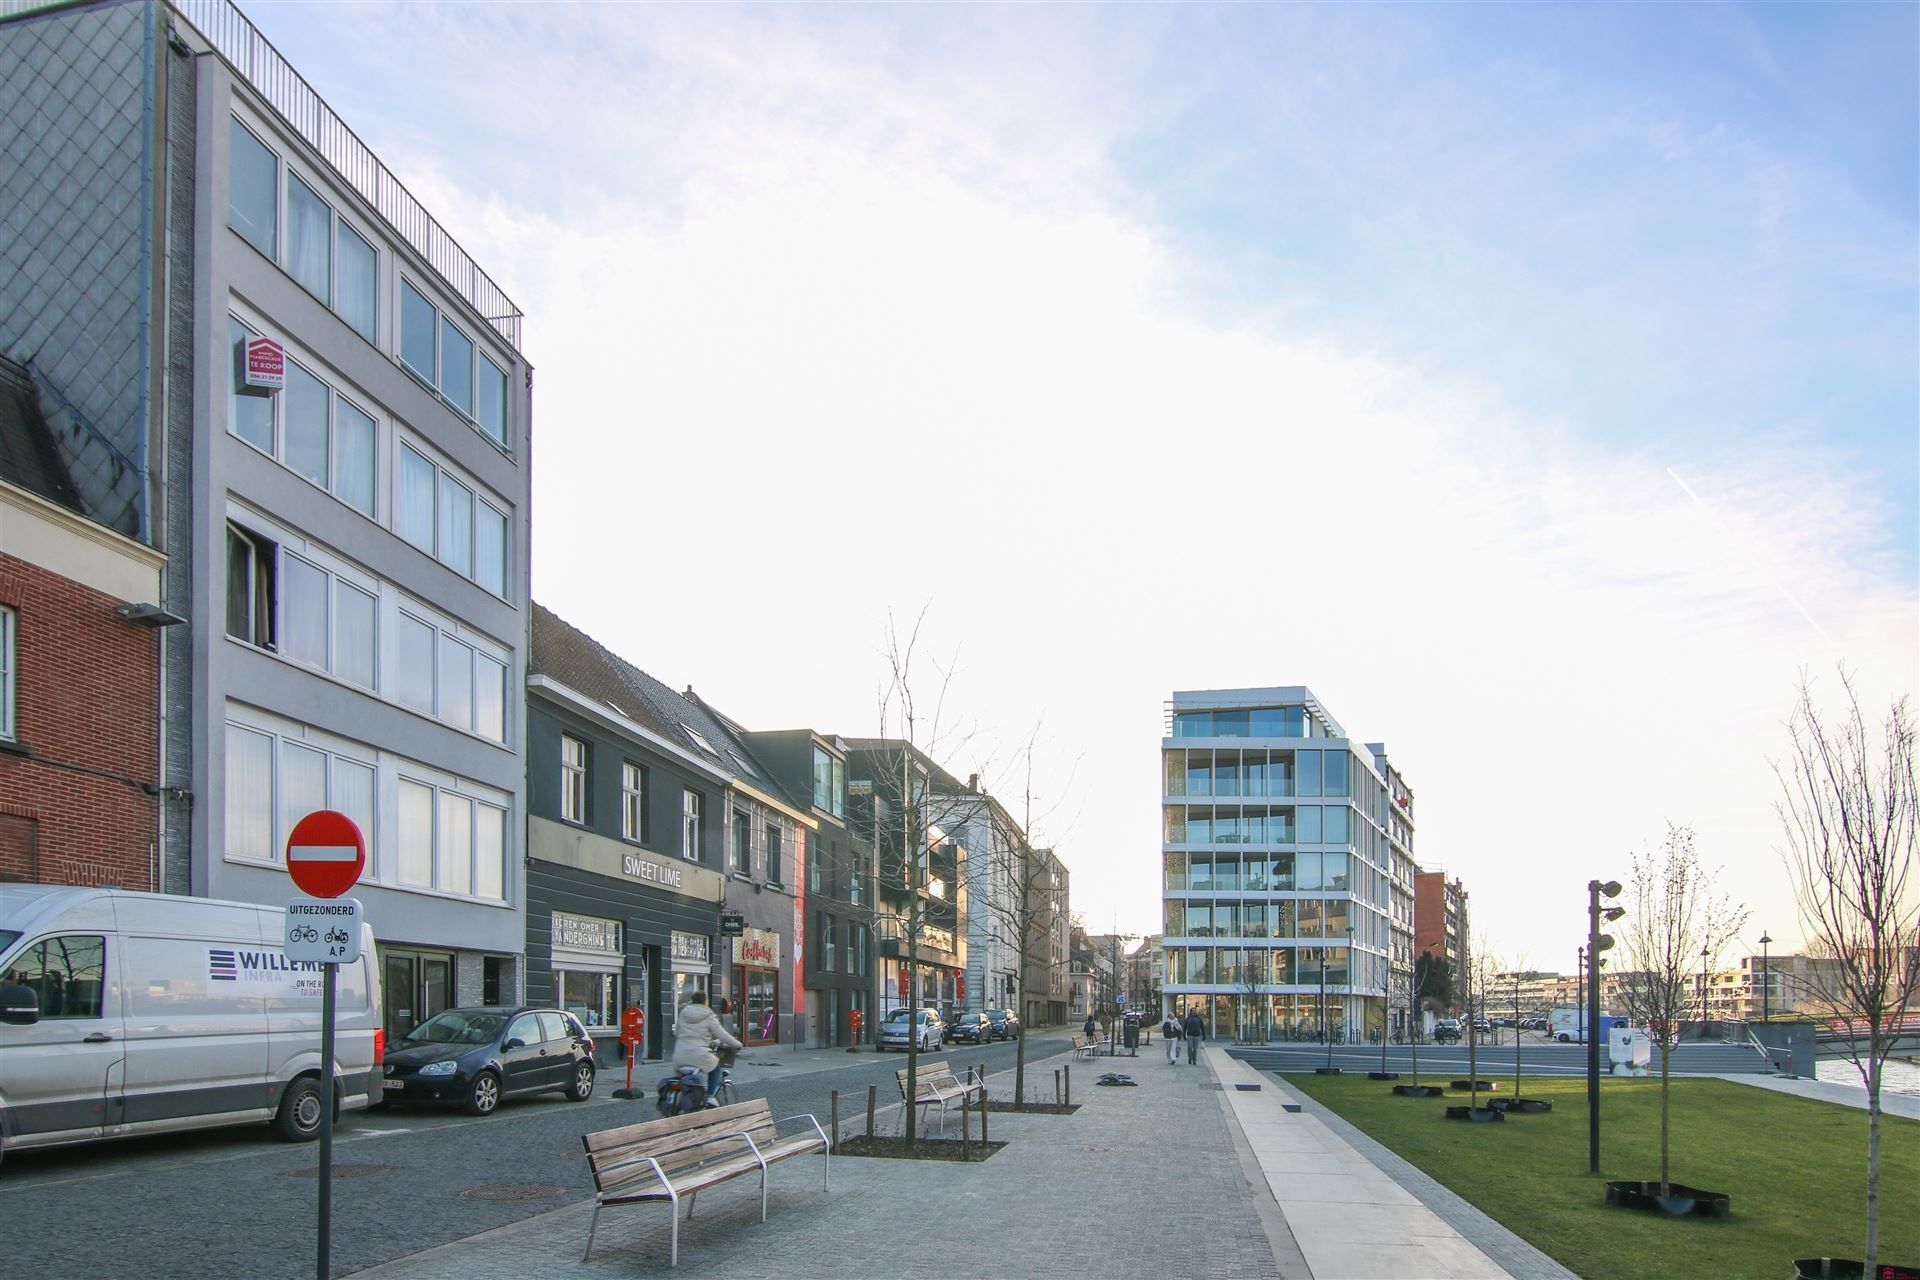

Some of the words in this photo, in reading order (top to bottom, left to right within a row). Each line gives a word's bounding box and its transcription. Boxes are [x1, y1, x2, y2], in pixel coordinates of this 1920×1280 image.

[260, 362, 282, 370] KOOP
[625, 856, 658, 881] SWEET
[660, 865, 681, 888] LIME
[290, 905, 354, 916] UITGEZONDERD
[580, 921, 599, 933] OMER
[244, 971, 282, 982] INFRA
[306, 980, 317, 988] THE
